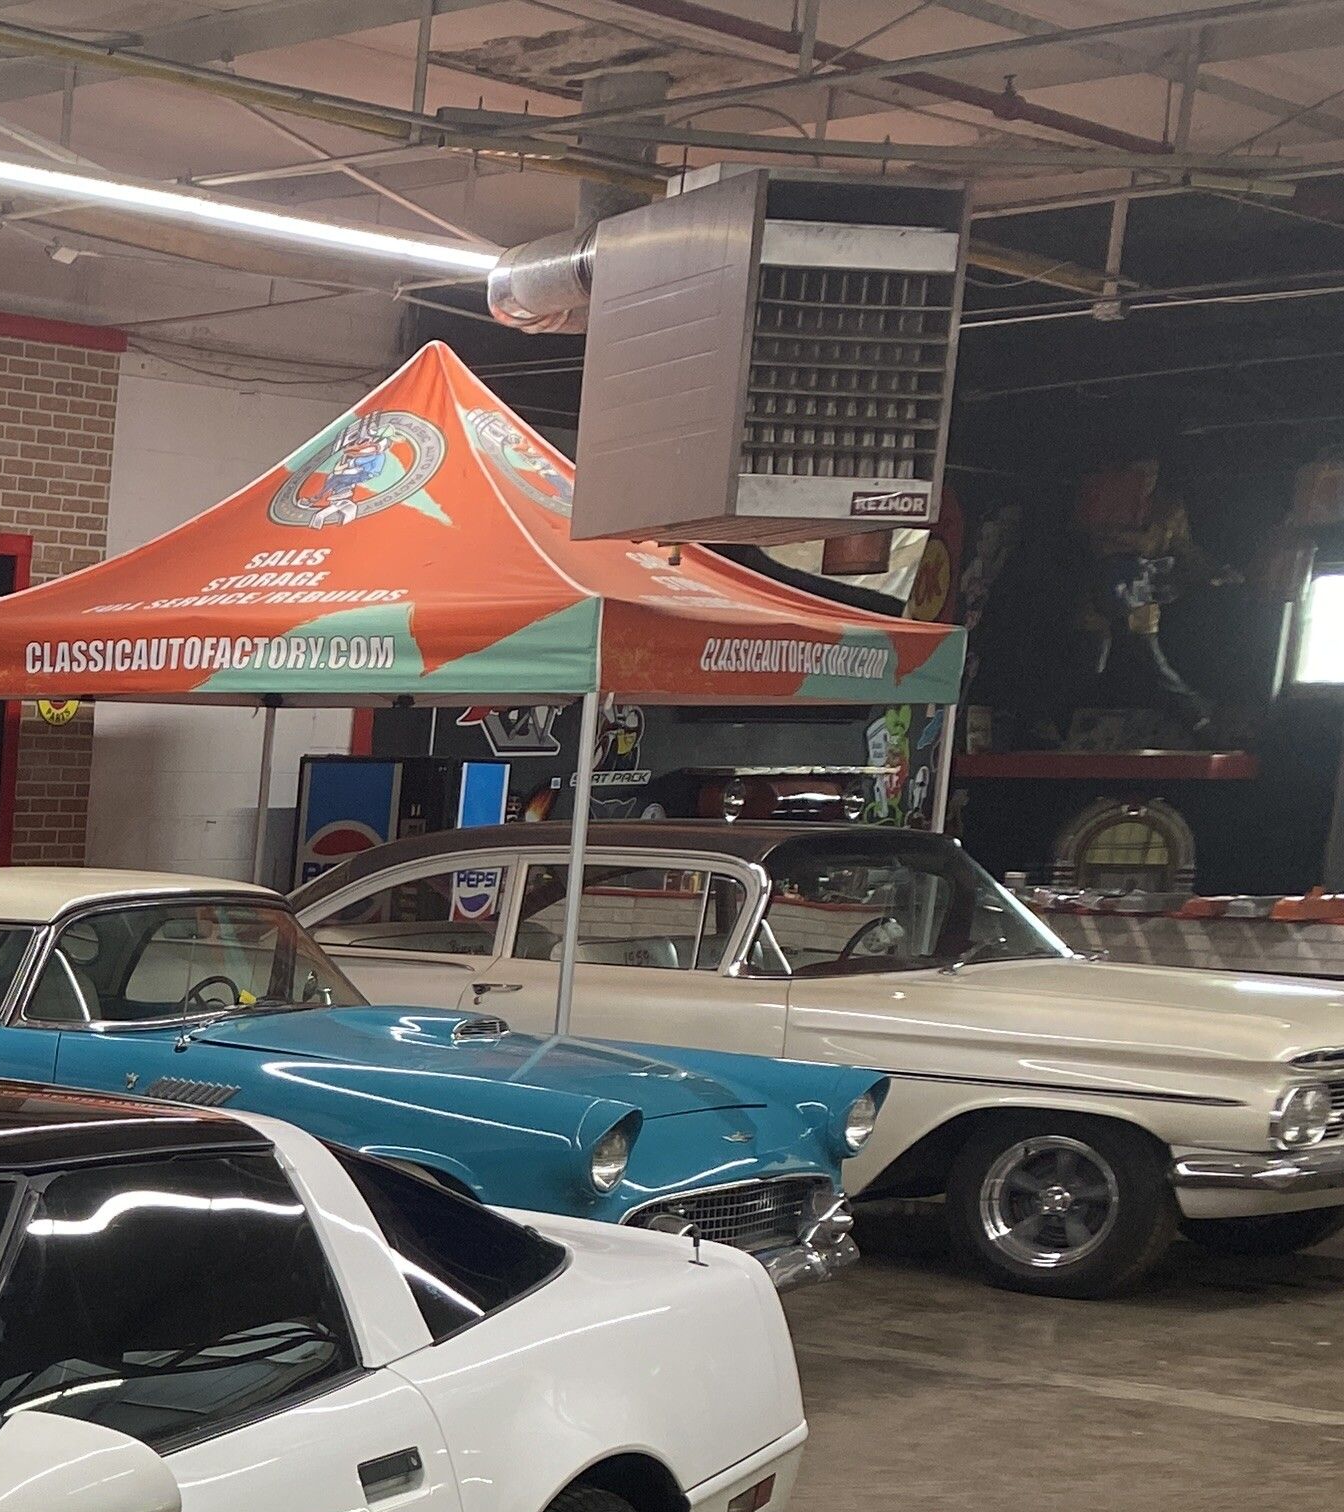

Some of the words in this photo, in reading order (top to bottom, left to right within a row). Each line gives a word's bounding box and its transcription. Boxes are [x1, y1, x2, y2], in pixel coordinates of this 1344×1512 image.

[854, 496, 924, 513] REZNOR
[244, 547, 332, 570] SALES
[201, 571, 332, 593] STORAGE
[143, 588, 410, 611] SERVICE/REBUILDS
[25, 634, 395, 675] CLASSICAUTOFACTORY.COM
[699, 637, 889, 680] CLASSICAUTOFACTORY.COM
[612, 771, 650, 784] PACK
[456, 871, 498, 888] PEPSI
